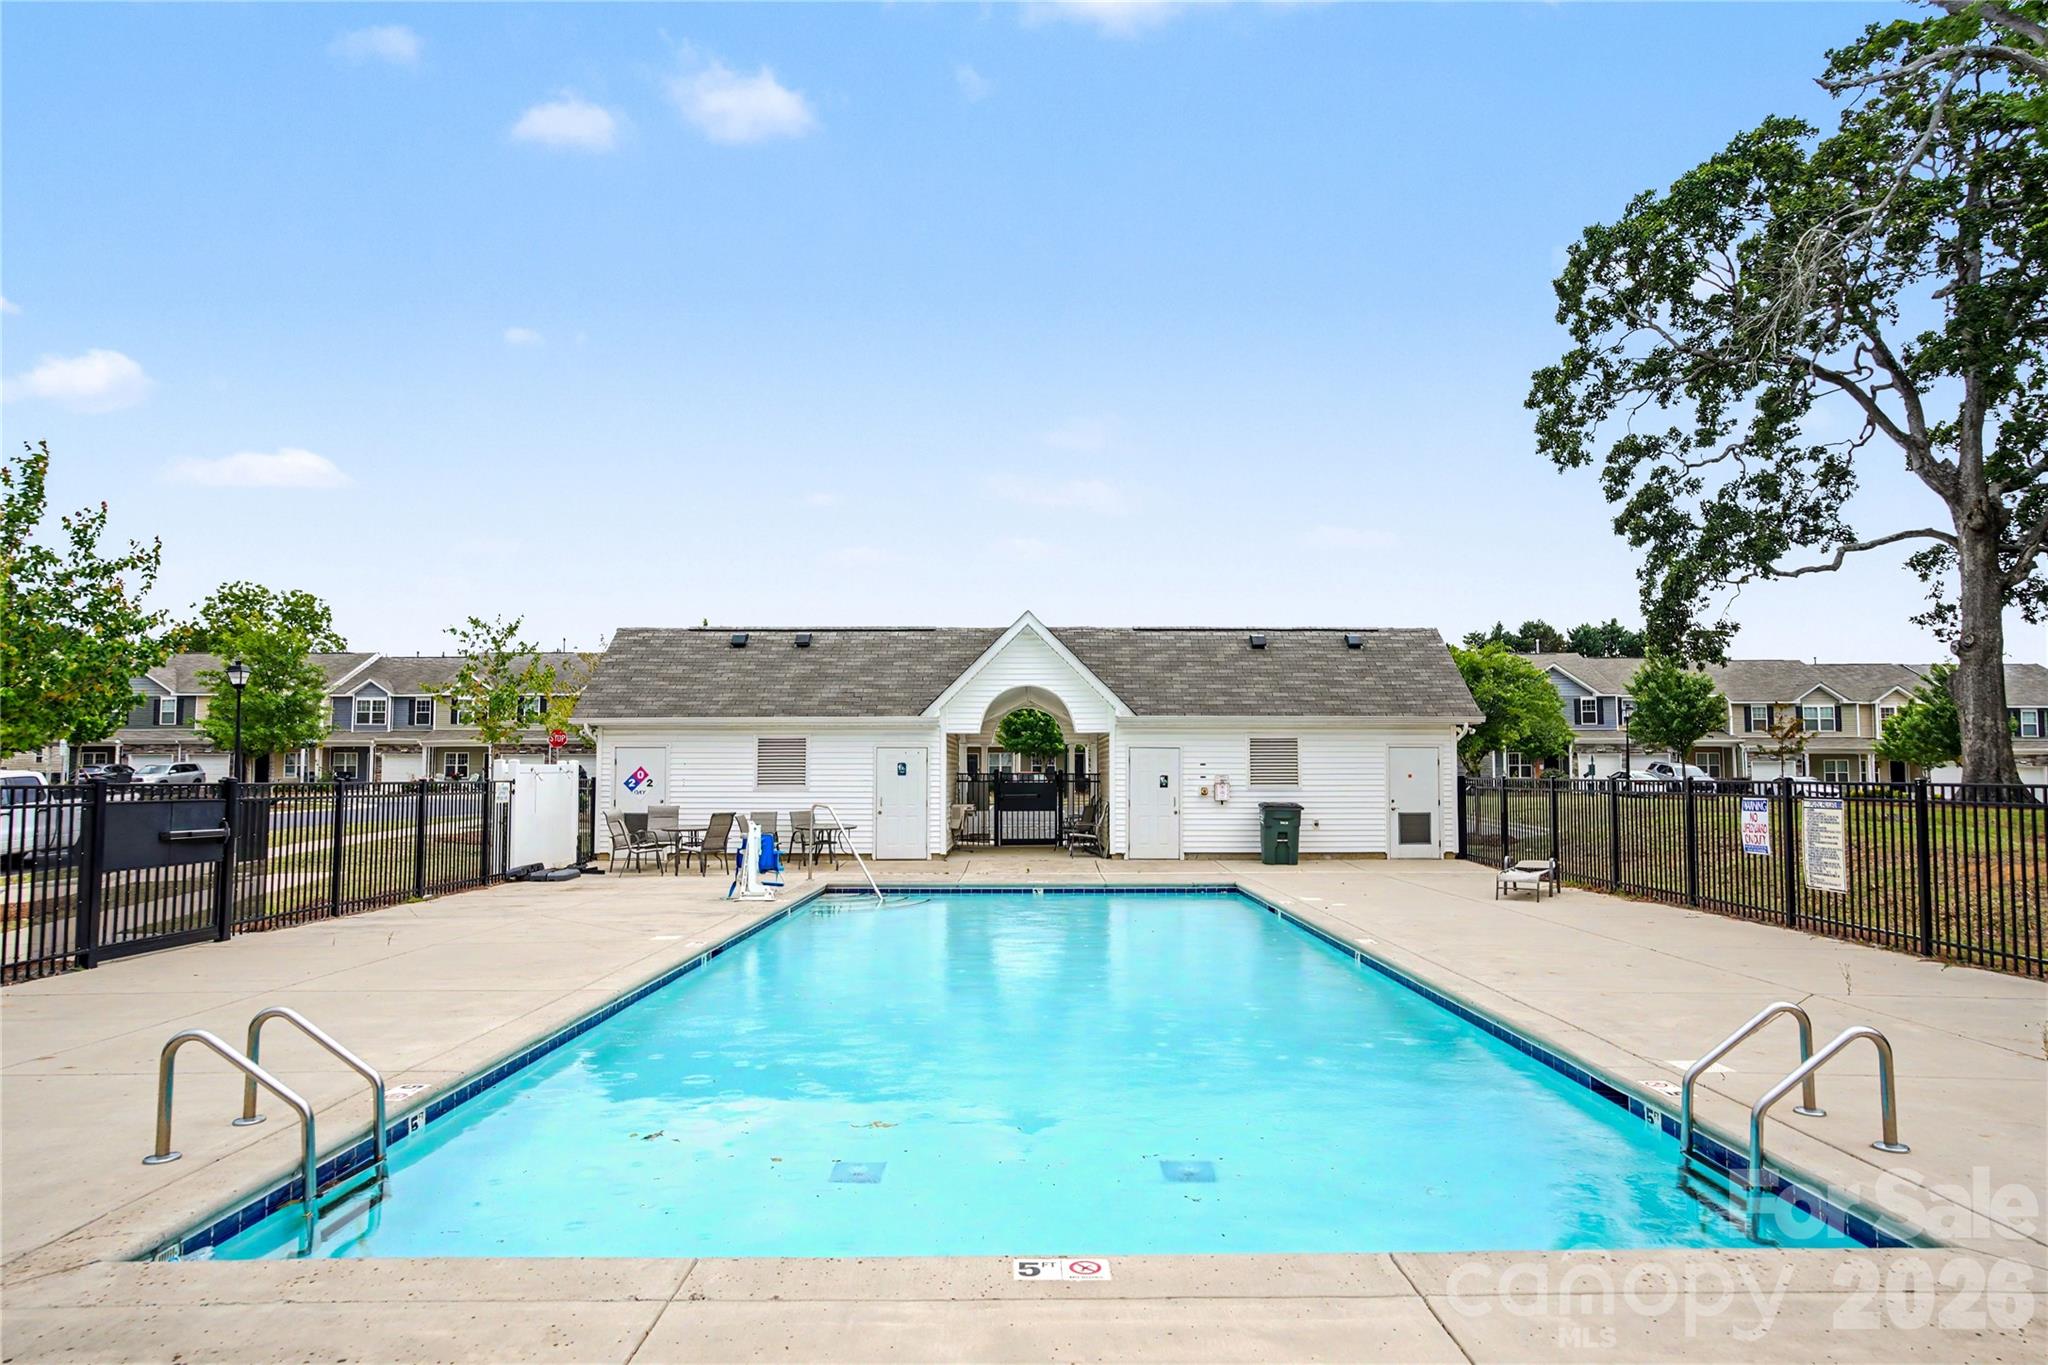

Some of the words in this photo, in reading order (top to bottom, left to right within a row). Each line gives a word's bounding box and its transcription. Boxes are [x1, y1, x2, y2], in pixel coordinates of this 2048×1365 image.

[549, 734, 566, 743] STOP
[637, 770, 645, 779] 0
[628, 779, 636, 788] 2
[646, 779, 653, 788] 2
[1750, 812, 1758, 823] NO
[1646, 1107, 1655, 1124] 5
[411, 1114, 419, 1132] 5
[1018, 1262, 1041, 1277] 5
